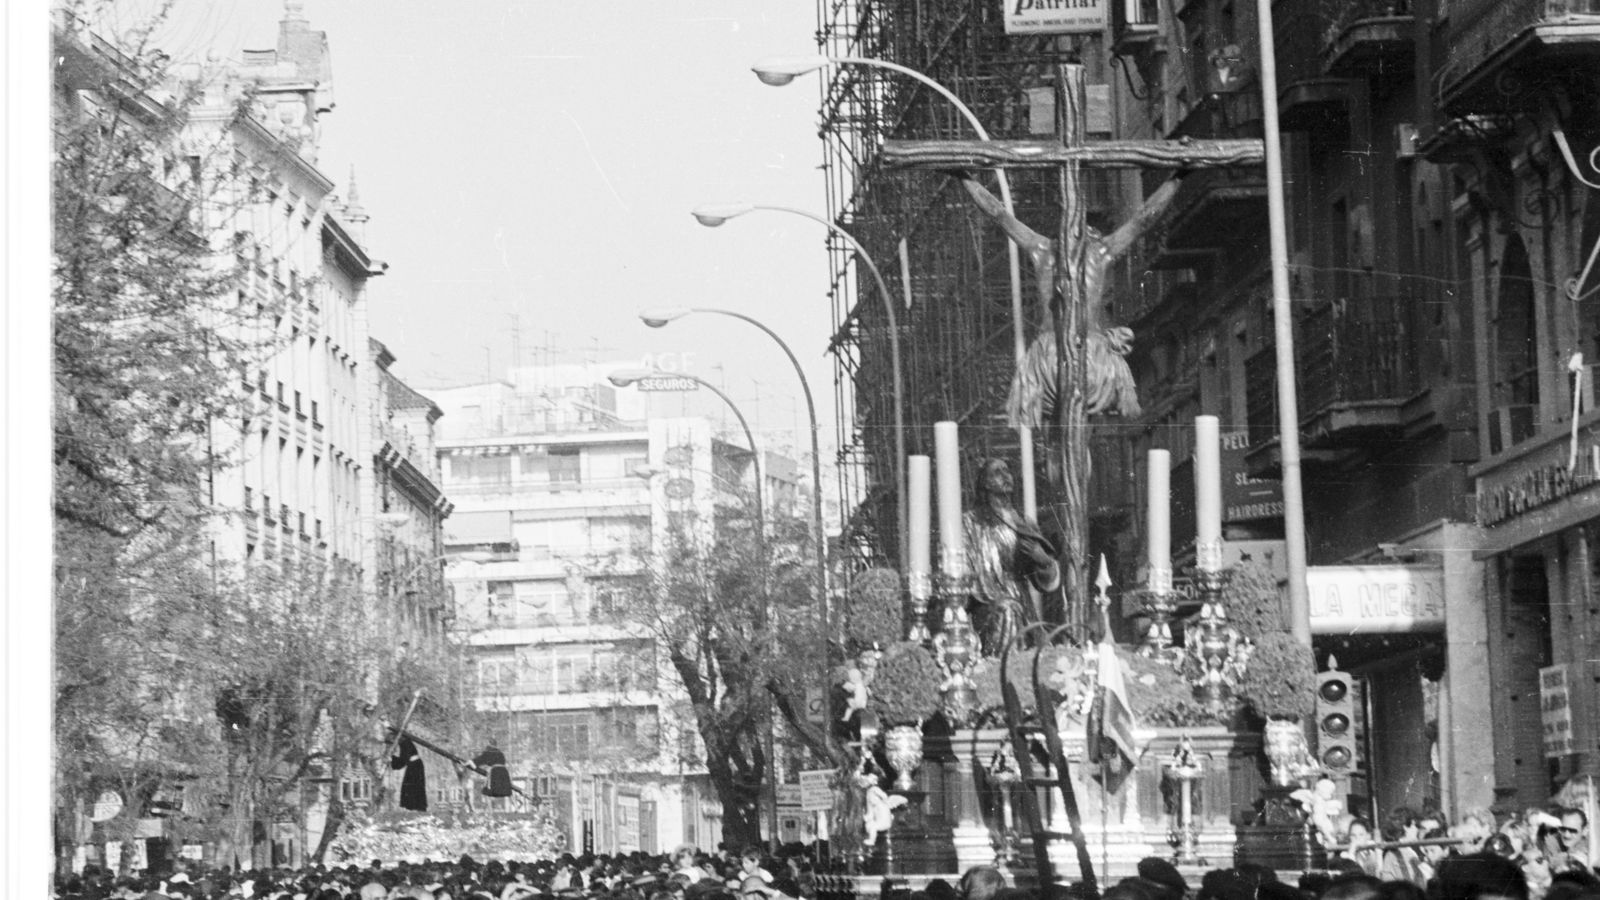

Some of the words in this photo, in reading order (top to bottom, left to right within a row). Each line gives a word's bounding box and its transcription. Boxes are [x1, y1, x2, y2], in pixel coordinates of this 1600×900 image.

[640, 352, 697, 372] AGF
[641, 379, 697, 390] SEGUROS
[1309, 583, 1343, 617] LA
